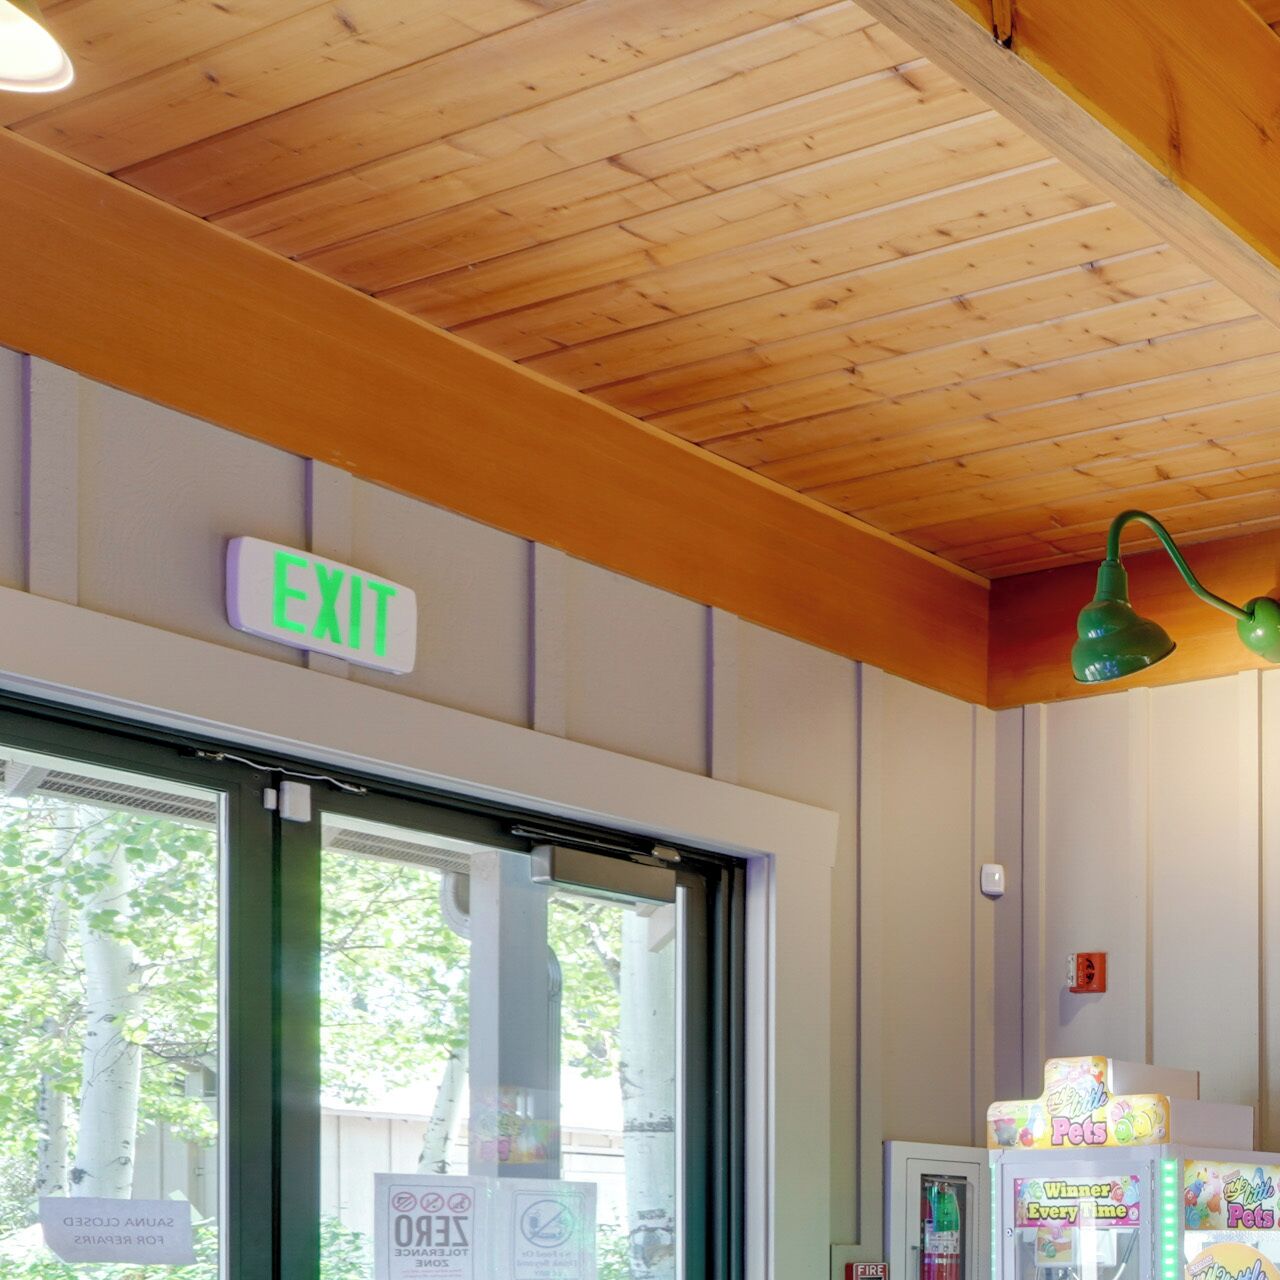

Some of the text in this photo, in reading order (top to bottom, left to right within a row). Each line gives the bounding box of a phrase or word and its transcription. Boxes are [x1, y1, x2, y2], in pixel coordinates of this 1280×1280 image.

[273, 549, 398, 658] EXIT
[1051, 1115, 1107, 1146] Pets
[1043, 1181, 1111, 1200] Winner
[1244, 1177, 1275, 1206] little
[1027, 1201, 1128, 1224] Every Time
[1227, 1202, 1275, 1229] Pets
[857, 1265, 884, 1276] FIRE
